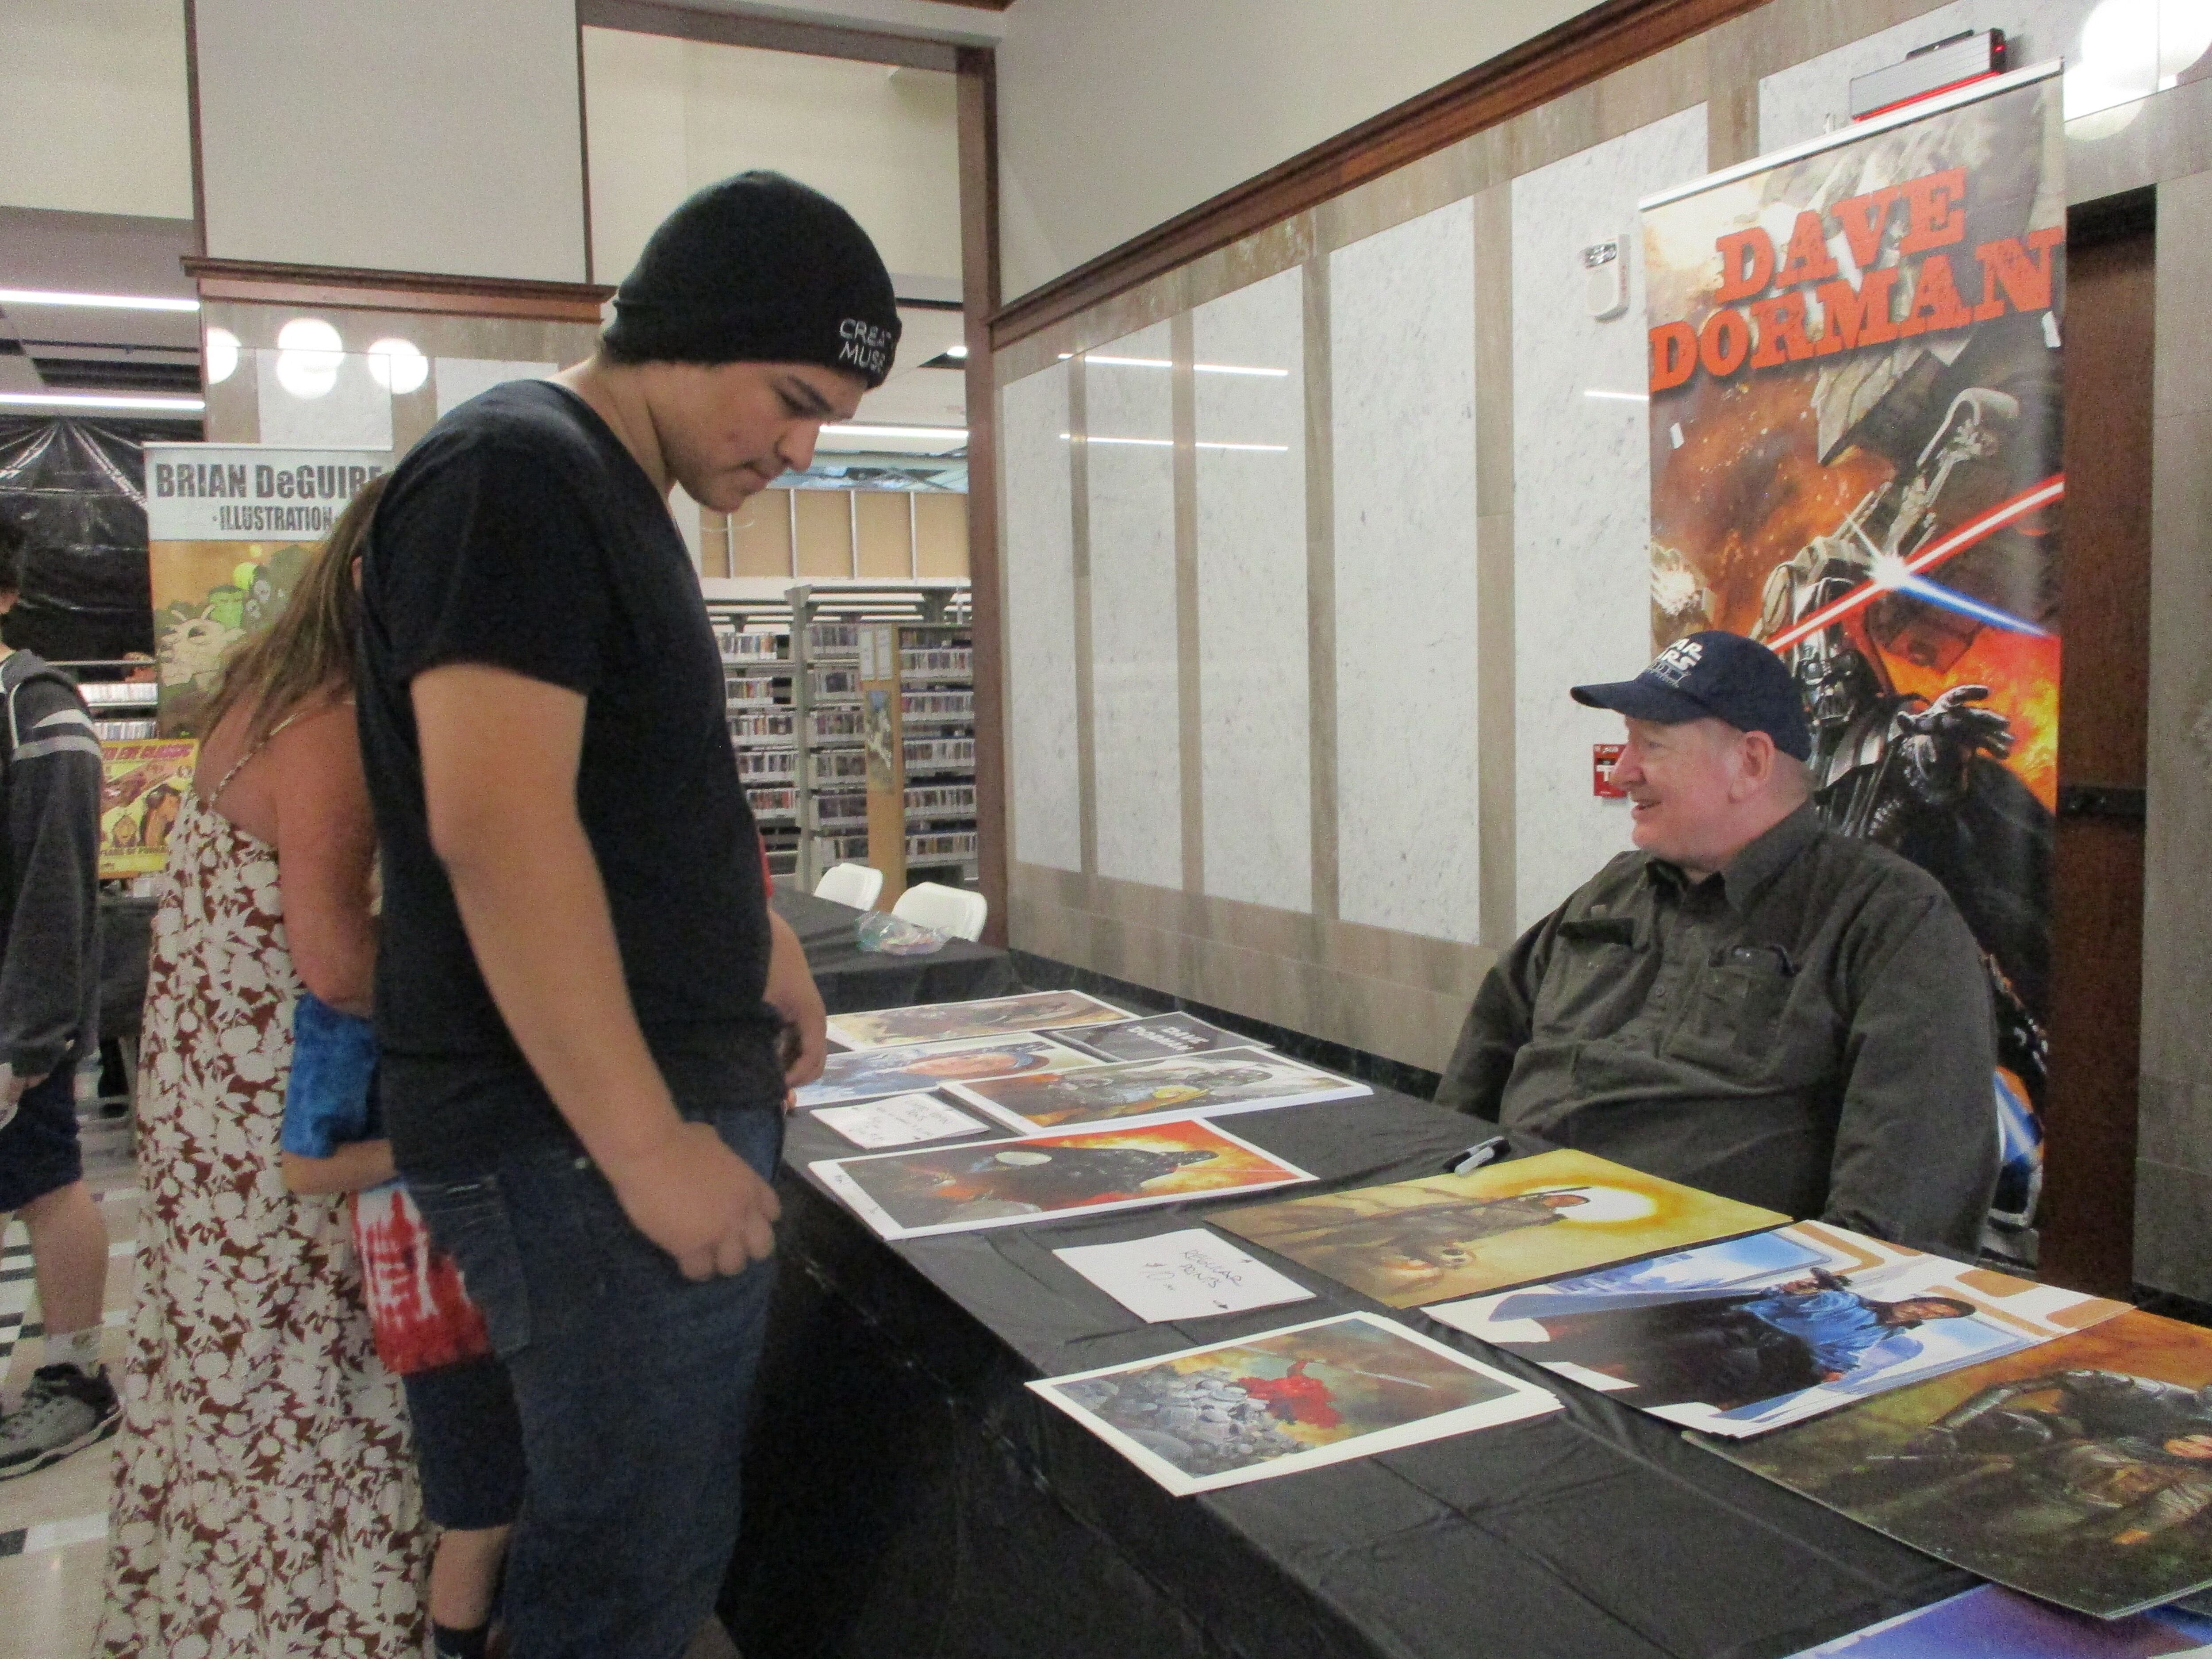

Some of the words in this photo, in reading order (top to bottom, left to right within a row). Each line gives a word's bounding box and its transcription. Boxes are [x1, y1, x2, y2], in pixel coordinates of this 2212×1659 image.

[1715, 167, 1966, 304] DAVE
[1649, 226, 2065, 393] DORMAN
[156, 463, 247, 498] BRIAN
[220, 505, 332, 531] ILLUSTRATION
